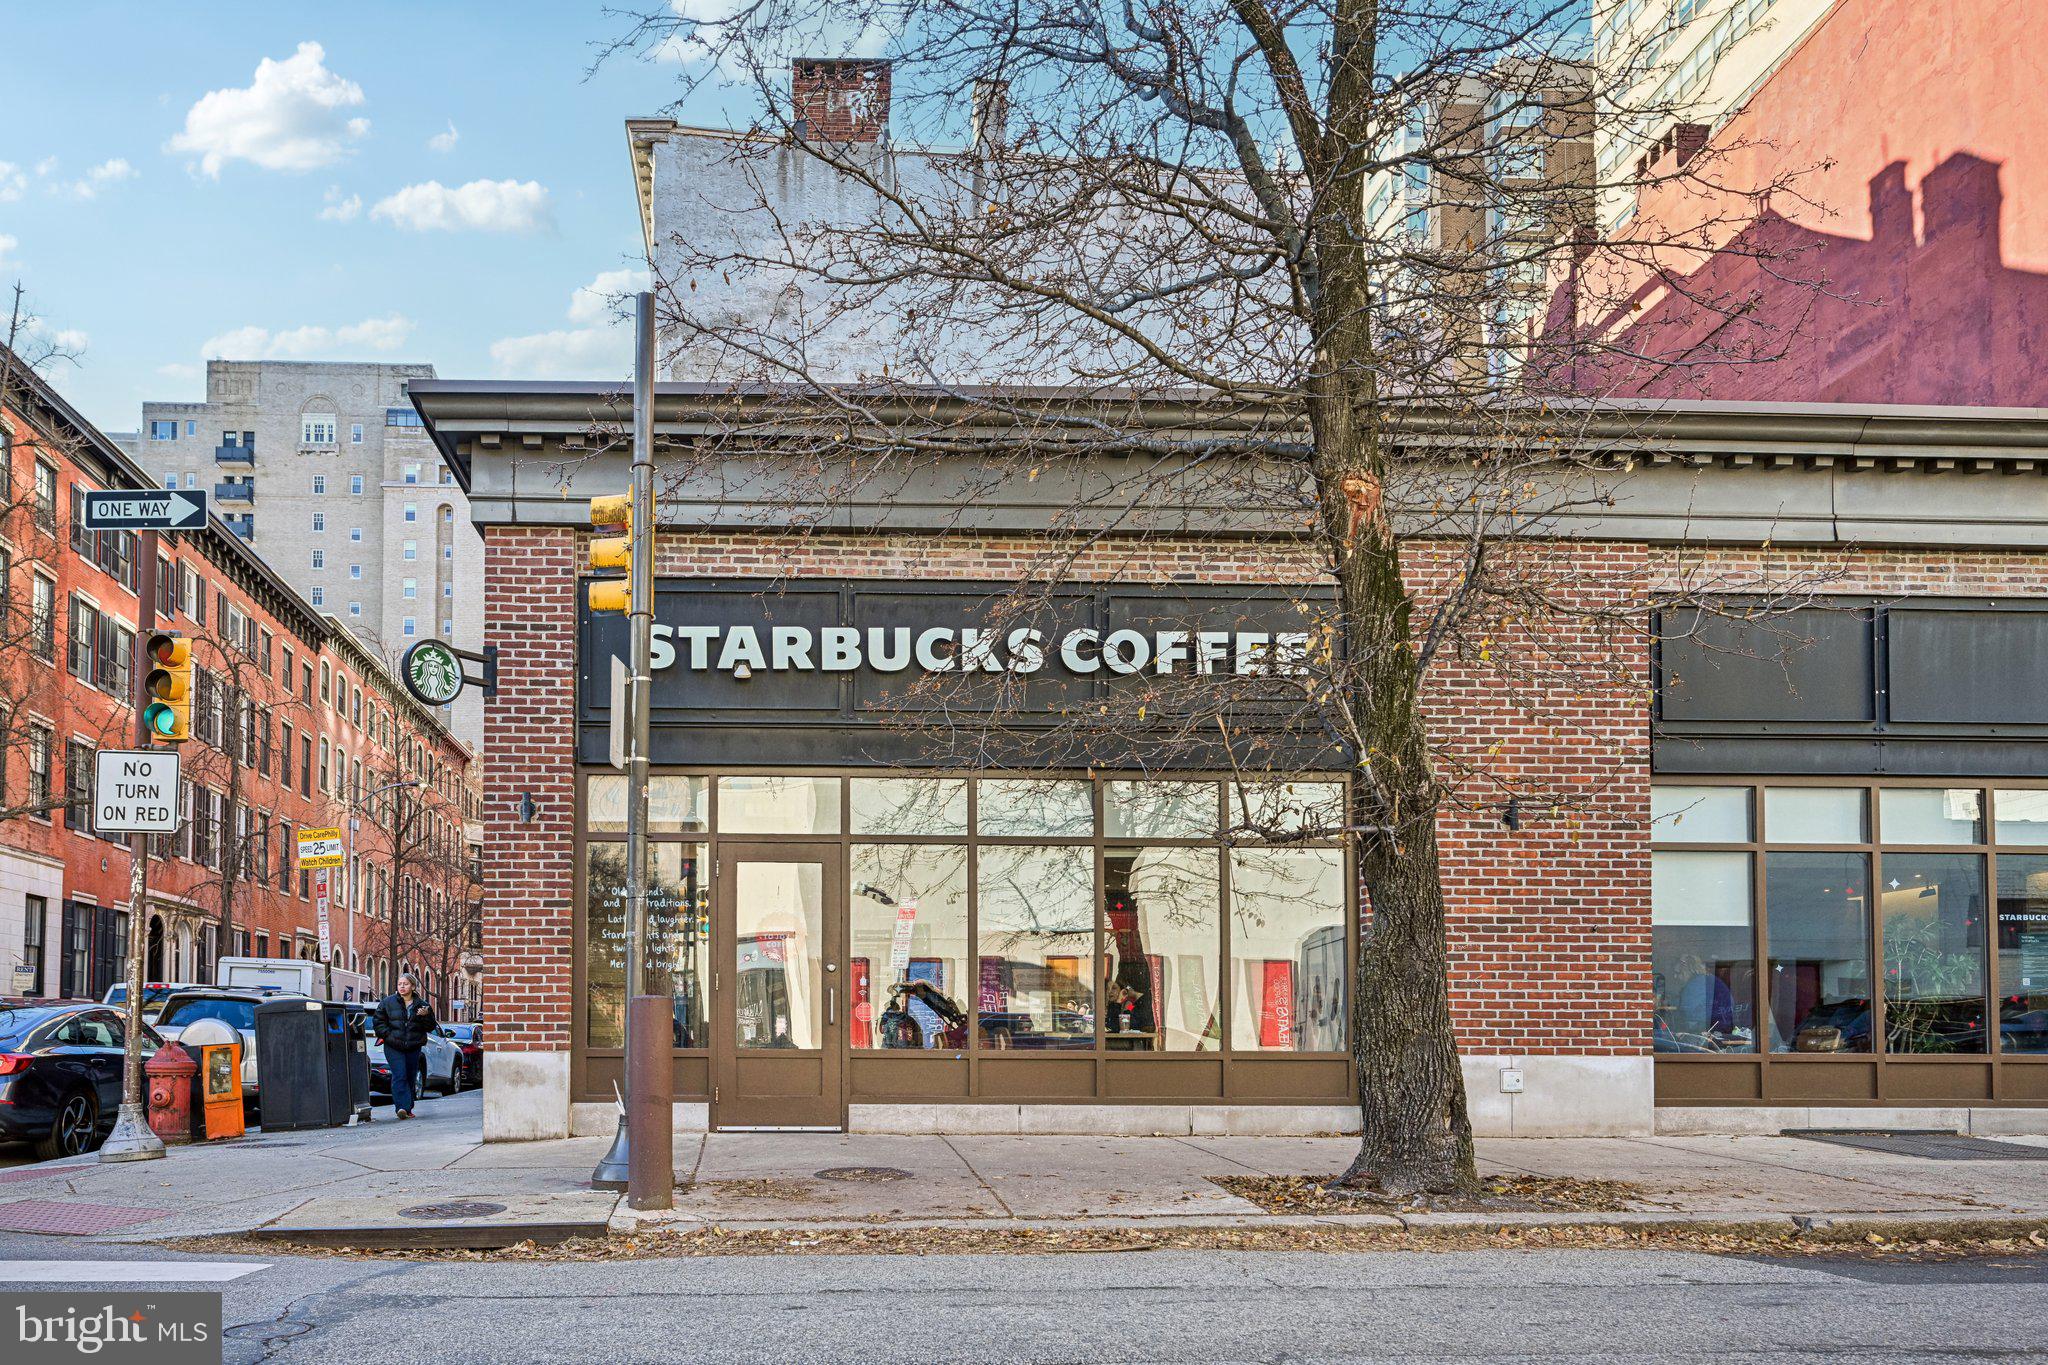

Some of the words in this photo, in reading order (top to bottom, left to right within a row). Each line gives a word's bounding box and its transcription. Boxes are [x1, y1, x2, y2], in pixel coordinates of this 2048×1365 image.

[98, 502, 132, 517] ONE
[138, 502, 170, 517] WAY
[649, 624, 1044, 674] STARBUCKS
[1060, 627, 1310, 676] COFFEE
[123, 761, 152, 777] NO
[115, 783, 160, 799] TURN
[103, 805, 126, 821] ON
[135, 806, 169, 822] RED
[300, 832, 313, 840] Drive
[300, 845, 312, 853] SPEED
[313, 841, 326, 855] 25
[326, 843, 339, 851] LIMIT
[301, 858, 318, 867] Watch
[319, 857, 341, 866] Children
[603, 898, 621, 907] and
